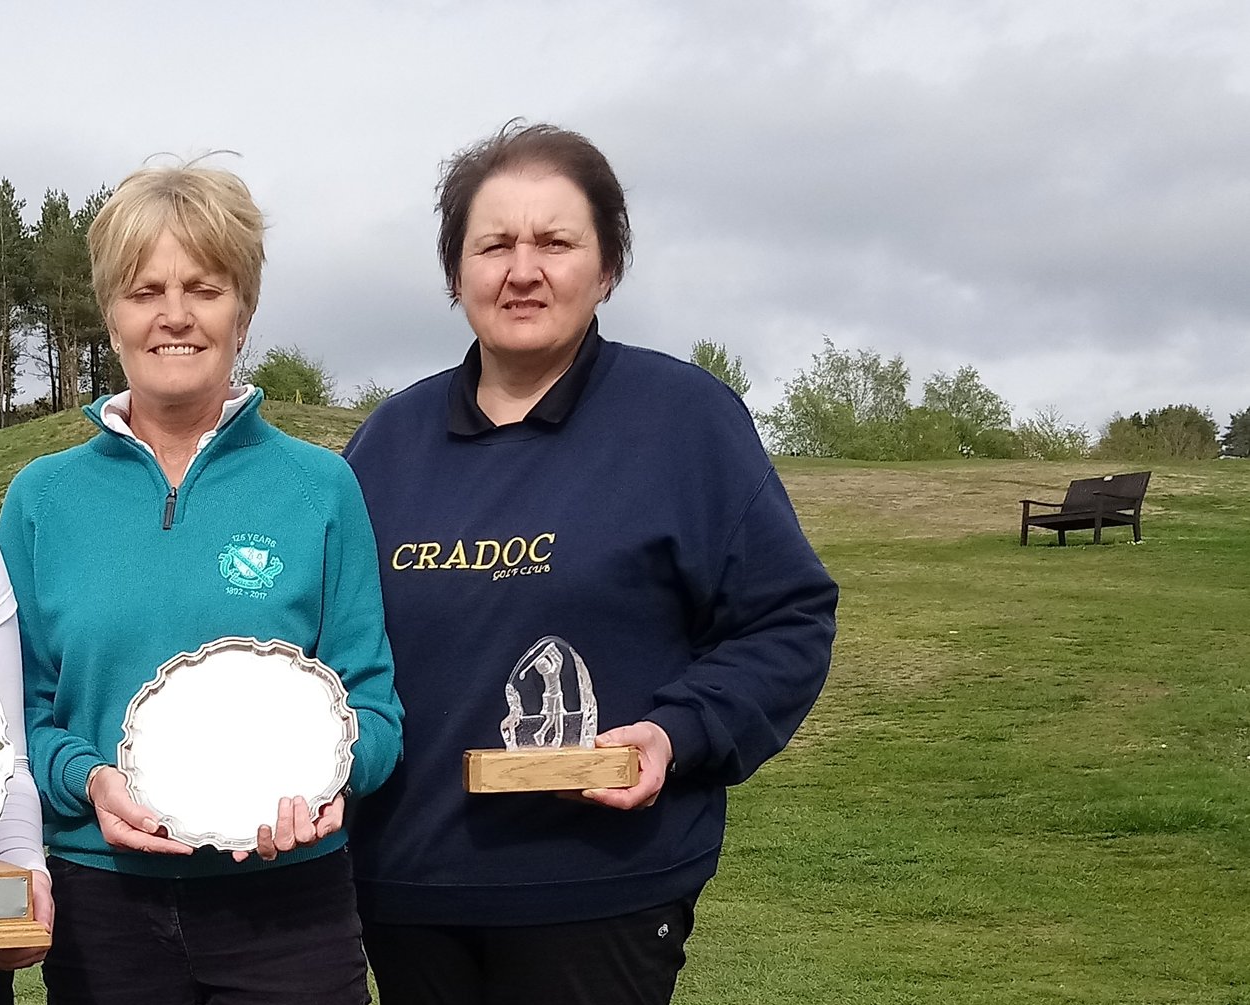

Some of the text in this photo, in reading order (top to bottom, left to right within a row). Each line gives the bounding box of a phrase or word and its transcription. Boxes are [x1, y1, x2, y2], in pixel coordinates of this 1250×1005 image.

[247, 533, 277, 548] YEARS
[392, 532, 556, 571] CRADOC
[250, 590, 268, 600] 2017
